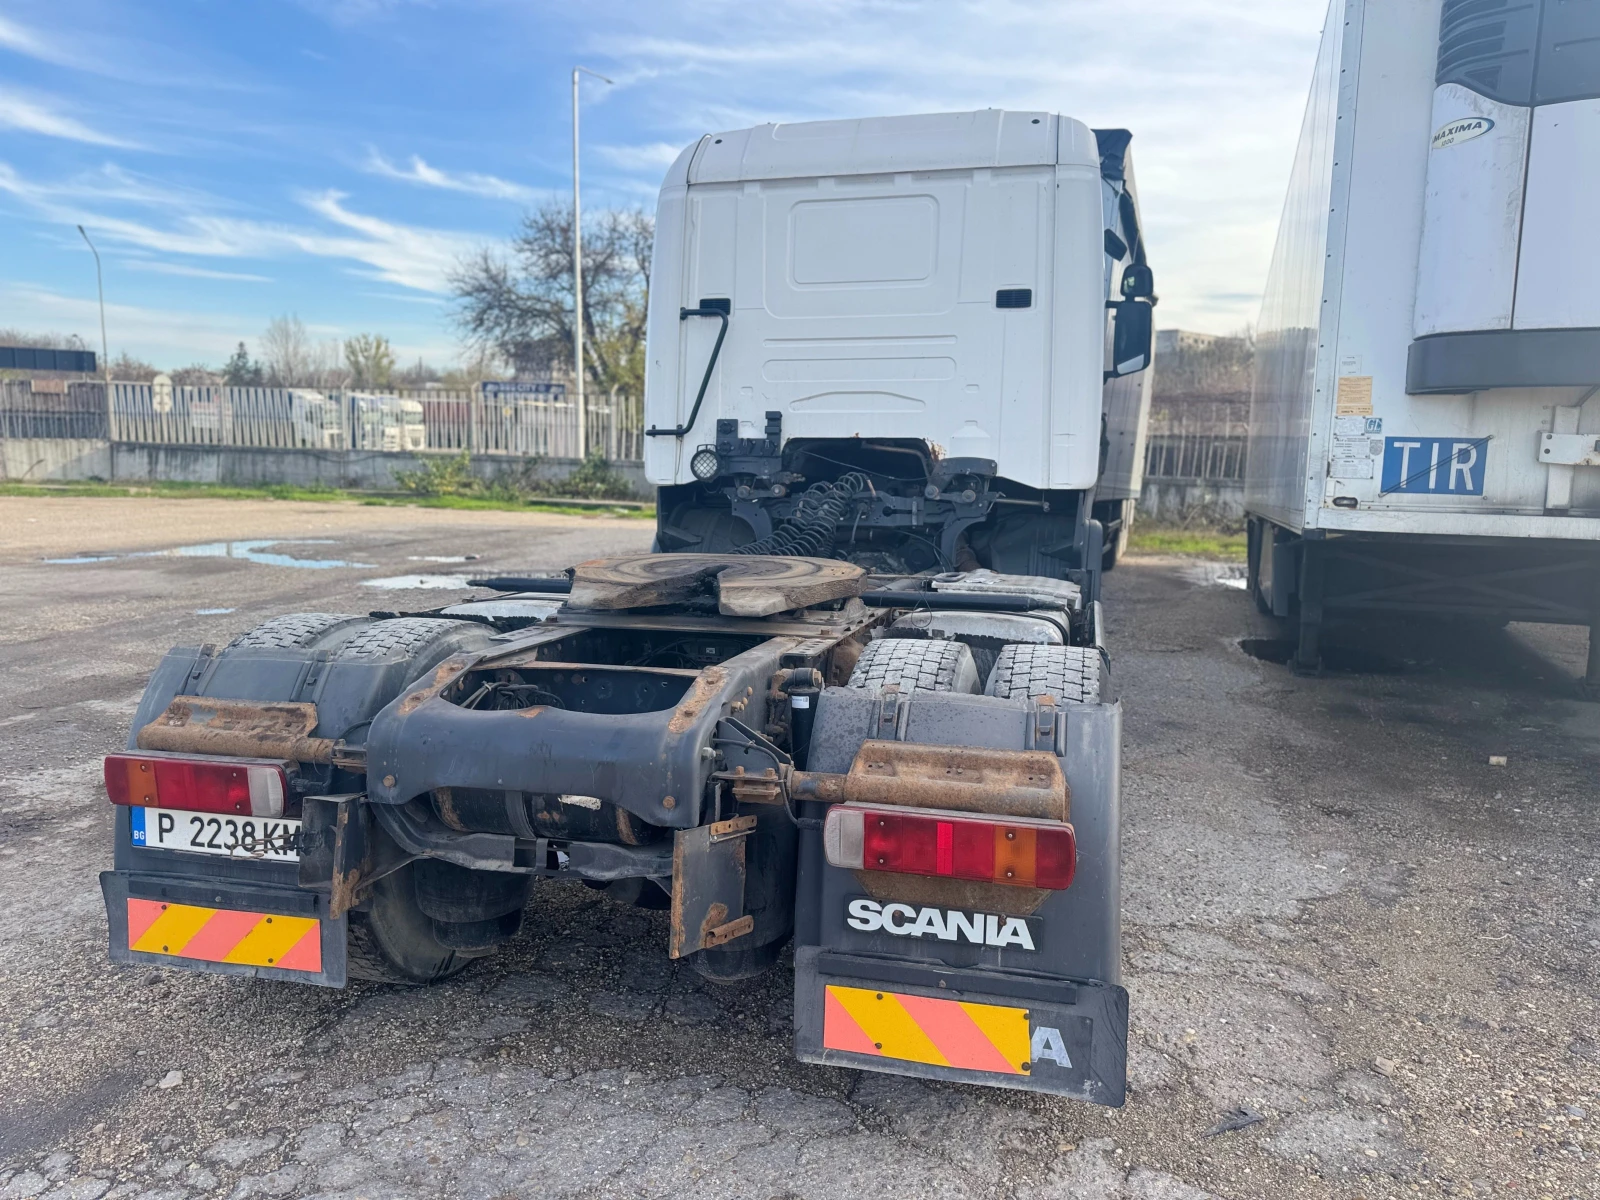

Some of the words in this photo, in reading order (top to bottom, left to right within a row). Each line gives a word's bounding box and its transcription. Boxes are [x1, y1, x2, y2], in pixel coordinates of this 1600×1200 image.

[1433, 122, 1481, 143] MAXIMA
[1393, 441, 1478, 491] TIR
[133, 830, 145, 841] BG
[157, 813, 175, 843] P
[189, 816, 256, 852] 2238
[847, 899, 1036, 951] SCANIA
